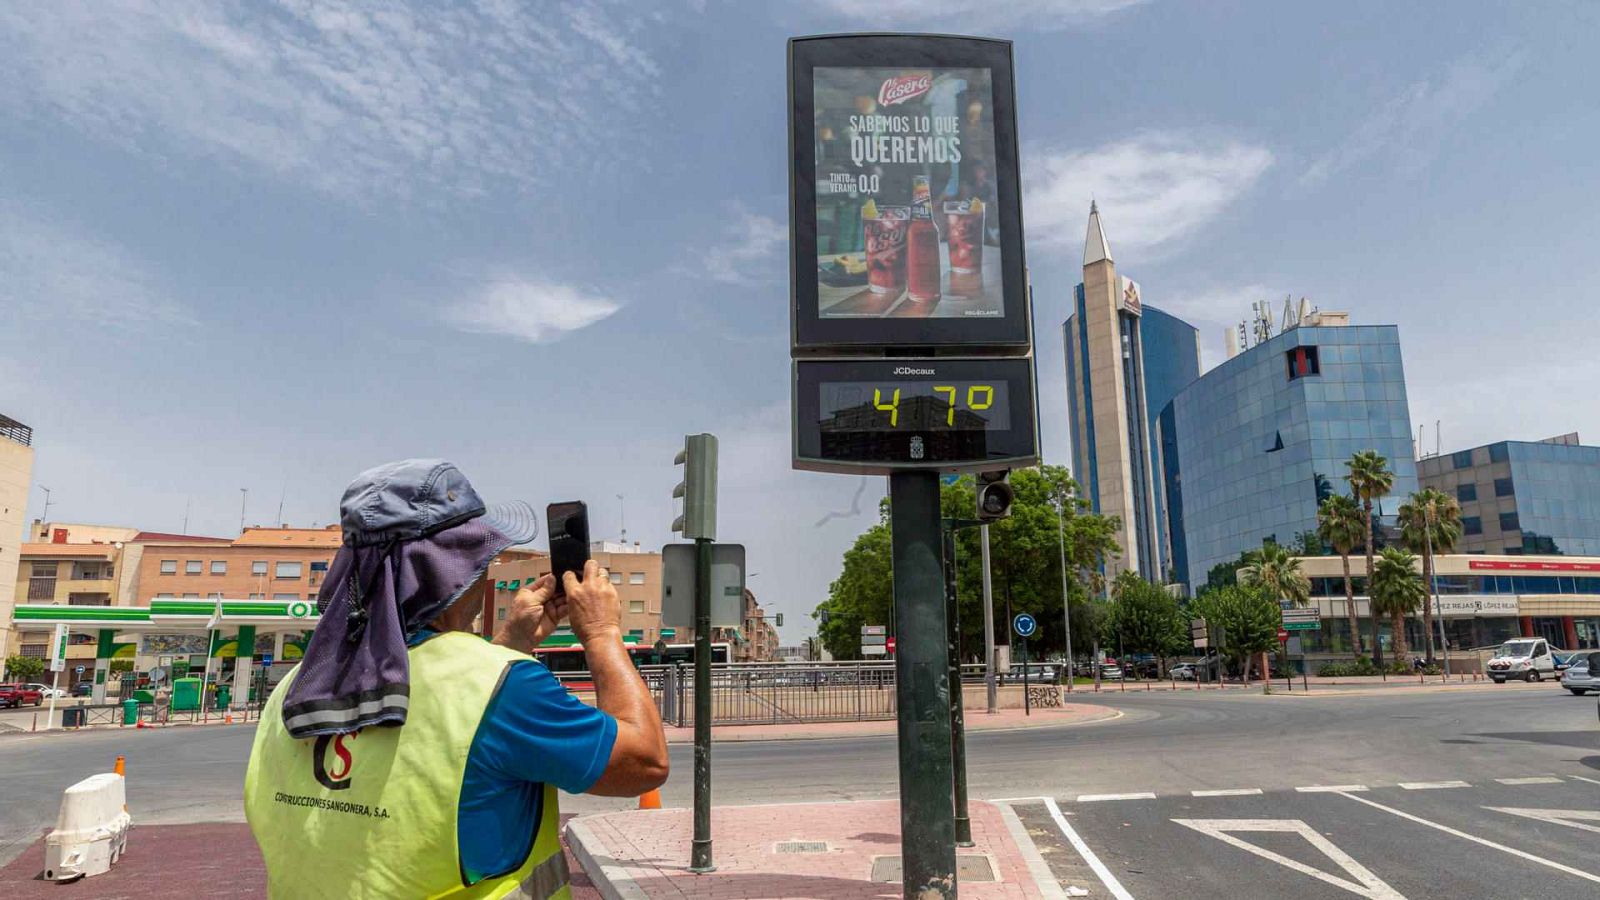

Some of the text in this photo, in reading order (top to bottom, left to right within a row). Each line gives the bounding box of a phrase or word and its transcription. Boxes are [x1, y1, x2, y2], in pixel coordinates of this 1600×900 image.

[878, 76, 929, 106] Casera
[850, 115, 960, 134] SABEMOS LO QUE
[851, 136, 962, 167] QUEREMOS
[829, 172, 850, 183] TINTO
[829, 183, 857, 193] VERANO
[893, 367, 935, 375] JCDecaux
[374, 807, 391, 819] S.A.
